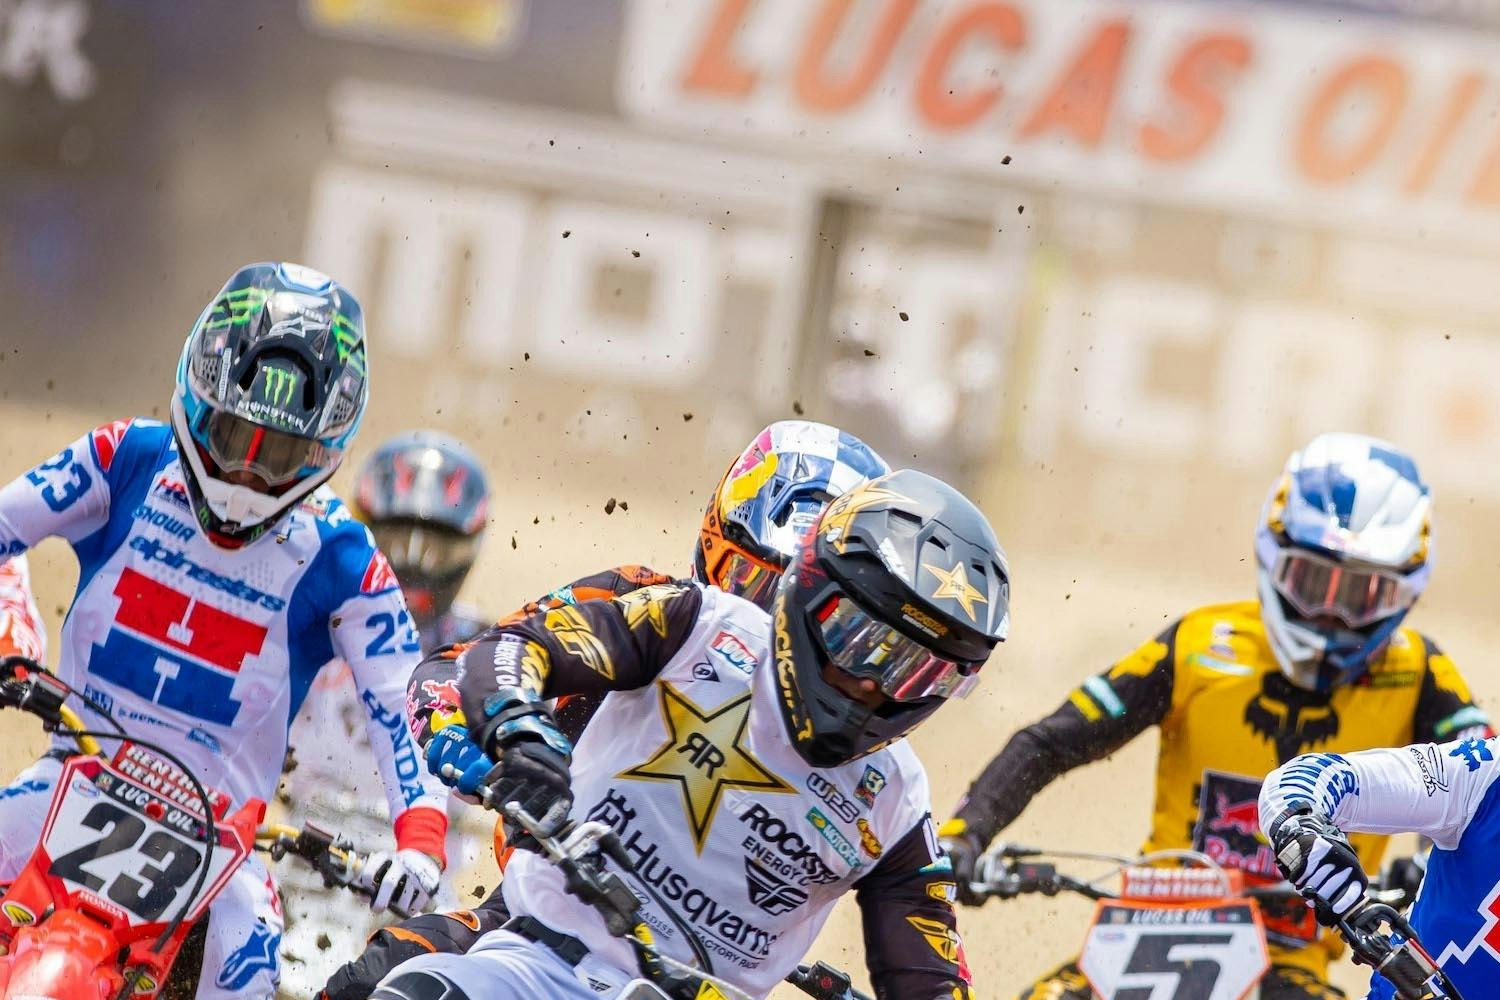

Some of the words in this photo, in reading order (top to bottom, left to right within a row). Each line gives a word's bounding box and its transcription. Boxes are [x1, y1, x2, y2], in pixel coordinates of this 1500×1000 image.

[682, 0, 1256, 168] LUCAS
[26, 446, 93, 513] 23
[47, 801, 203, 921] 23
[741, 835, 802, 883] ENERGY
[1130, 908, 1185, 923] LUCAS
